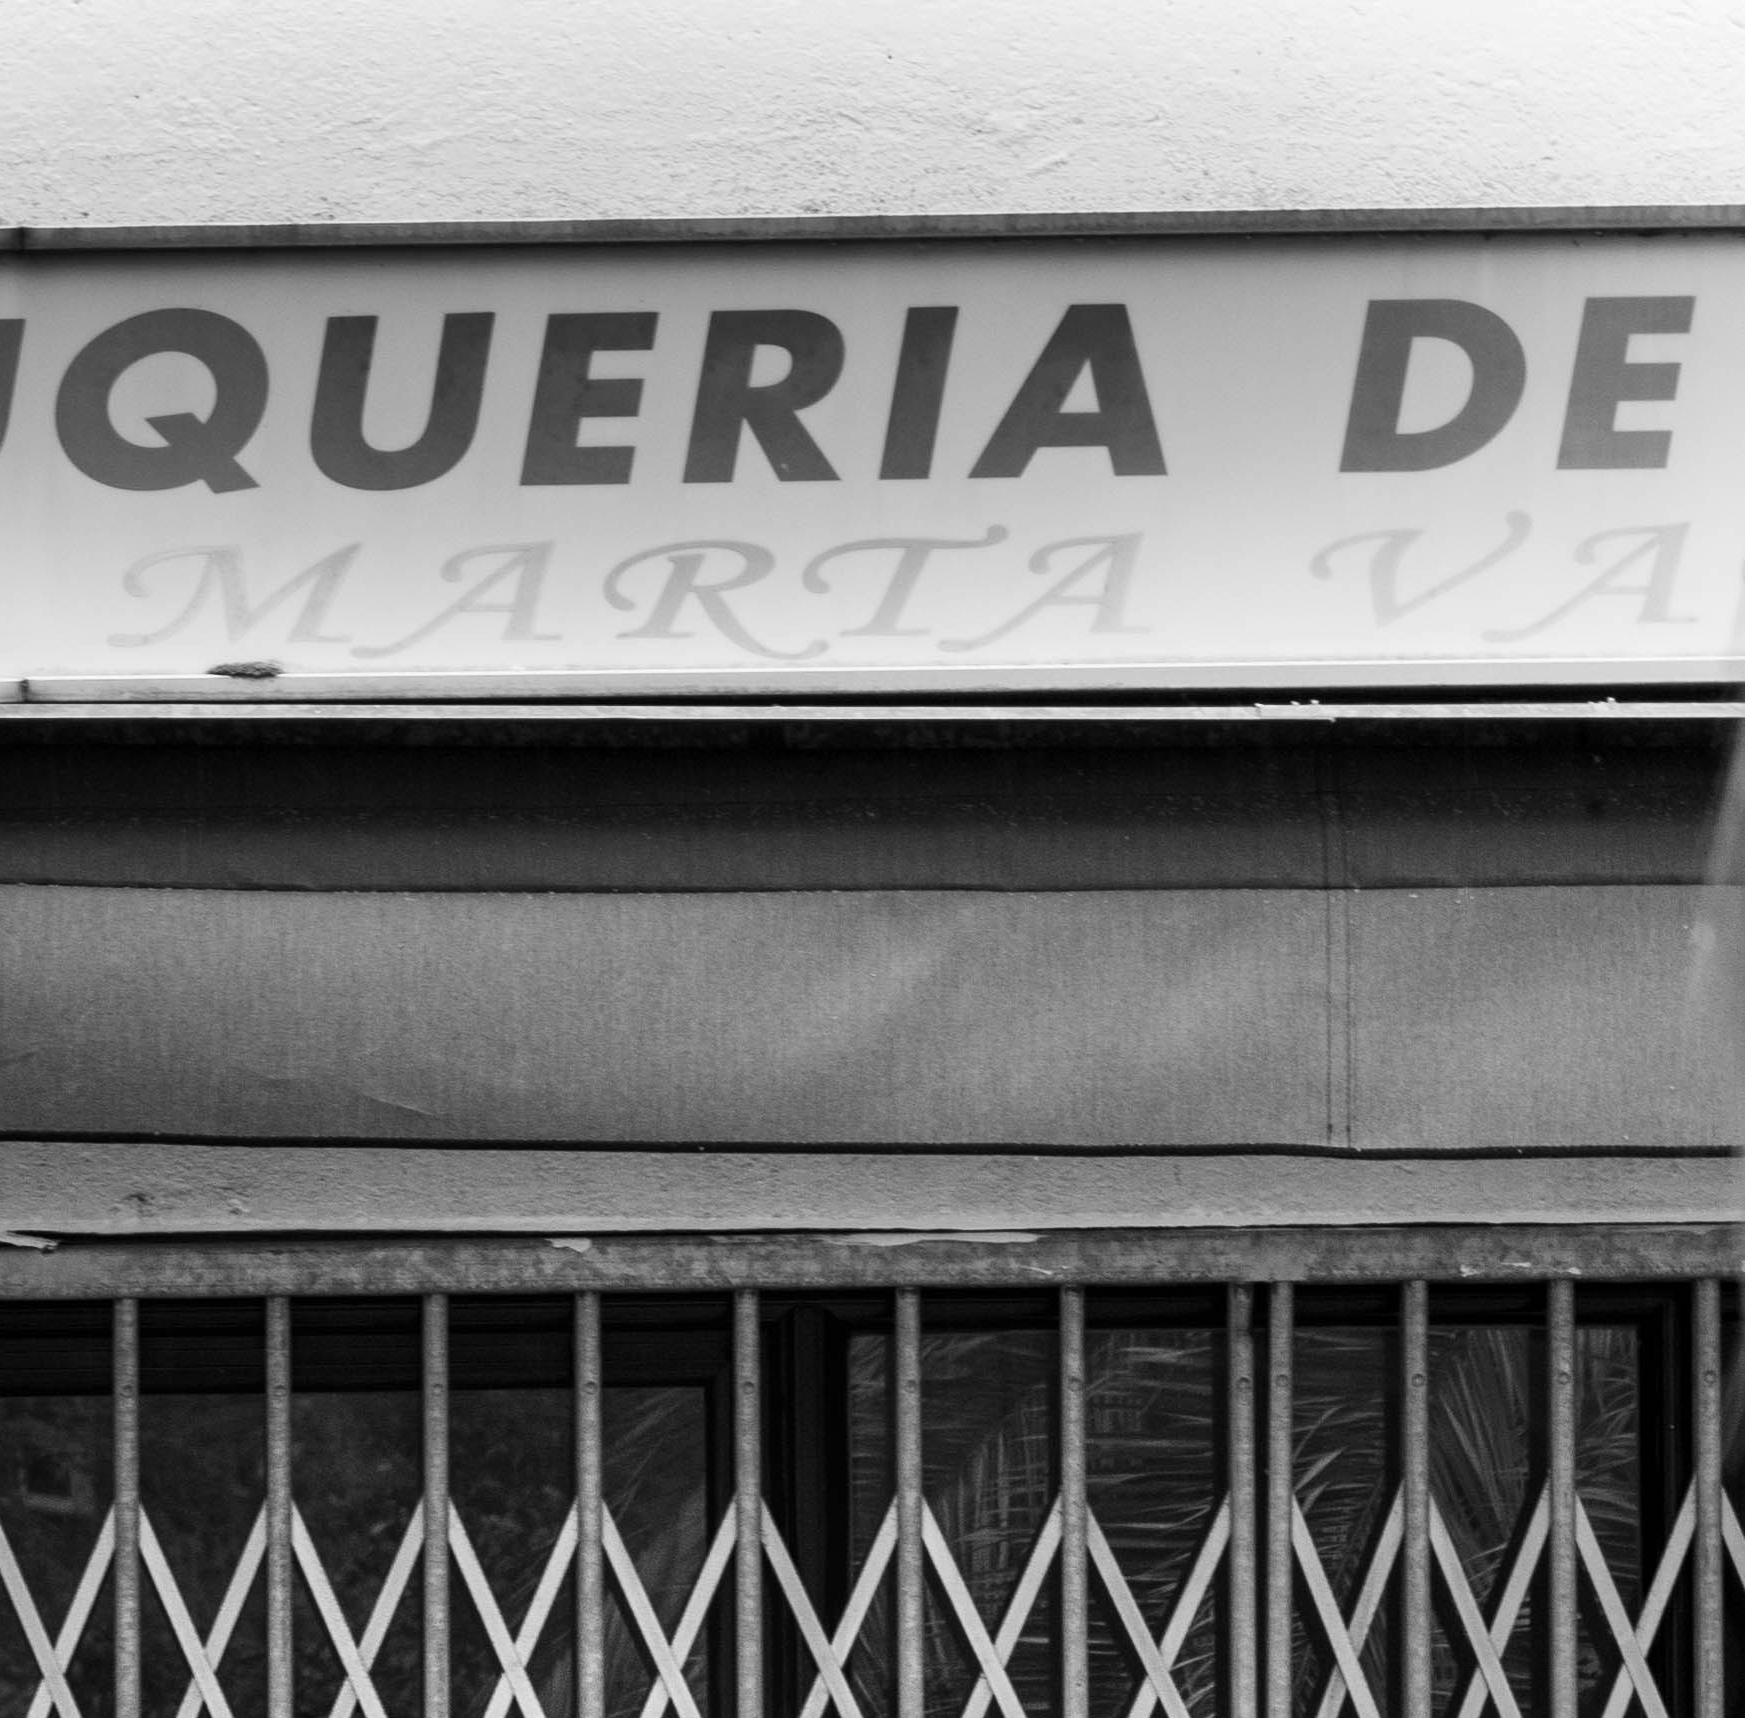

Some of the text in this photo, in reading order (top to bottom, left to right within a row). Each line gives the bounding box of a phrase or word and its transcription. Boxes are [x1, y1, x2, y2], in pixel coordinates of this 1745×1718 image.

[1339, 295, 1696, 473] DE
[107, 508, 1745, 659] MARTA VA
